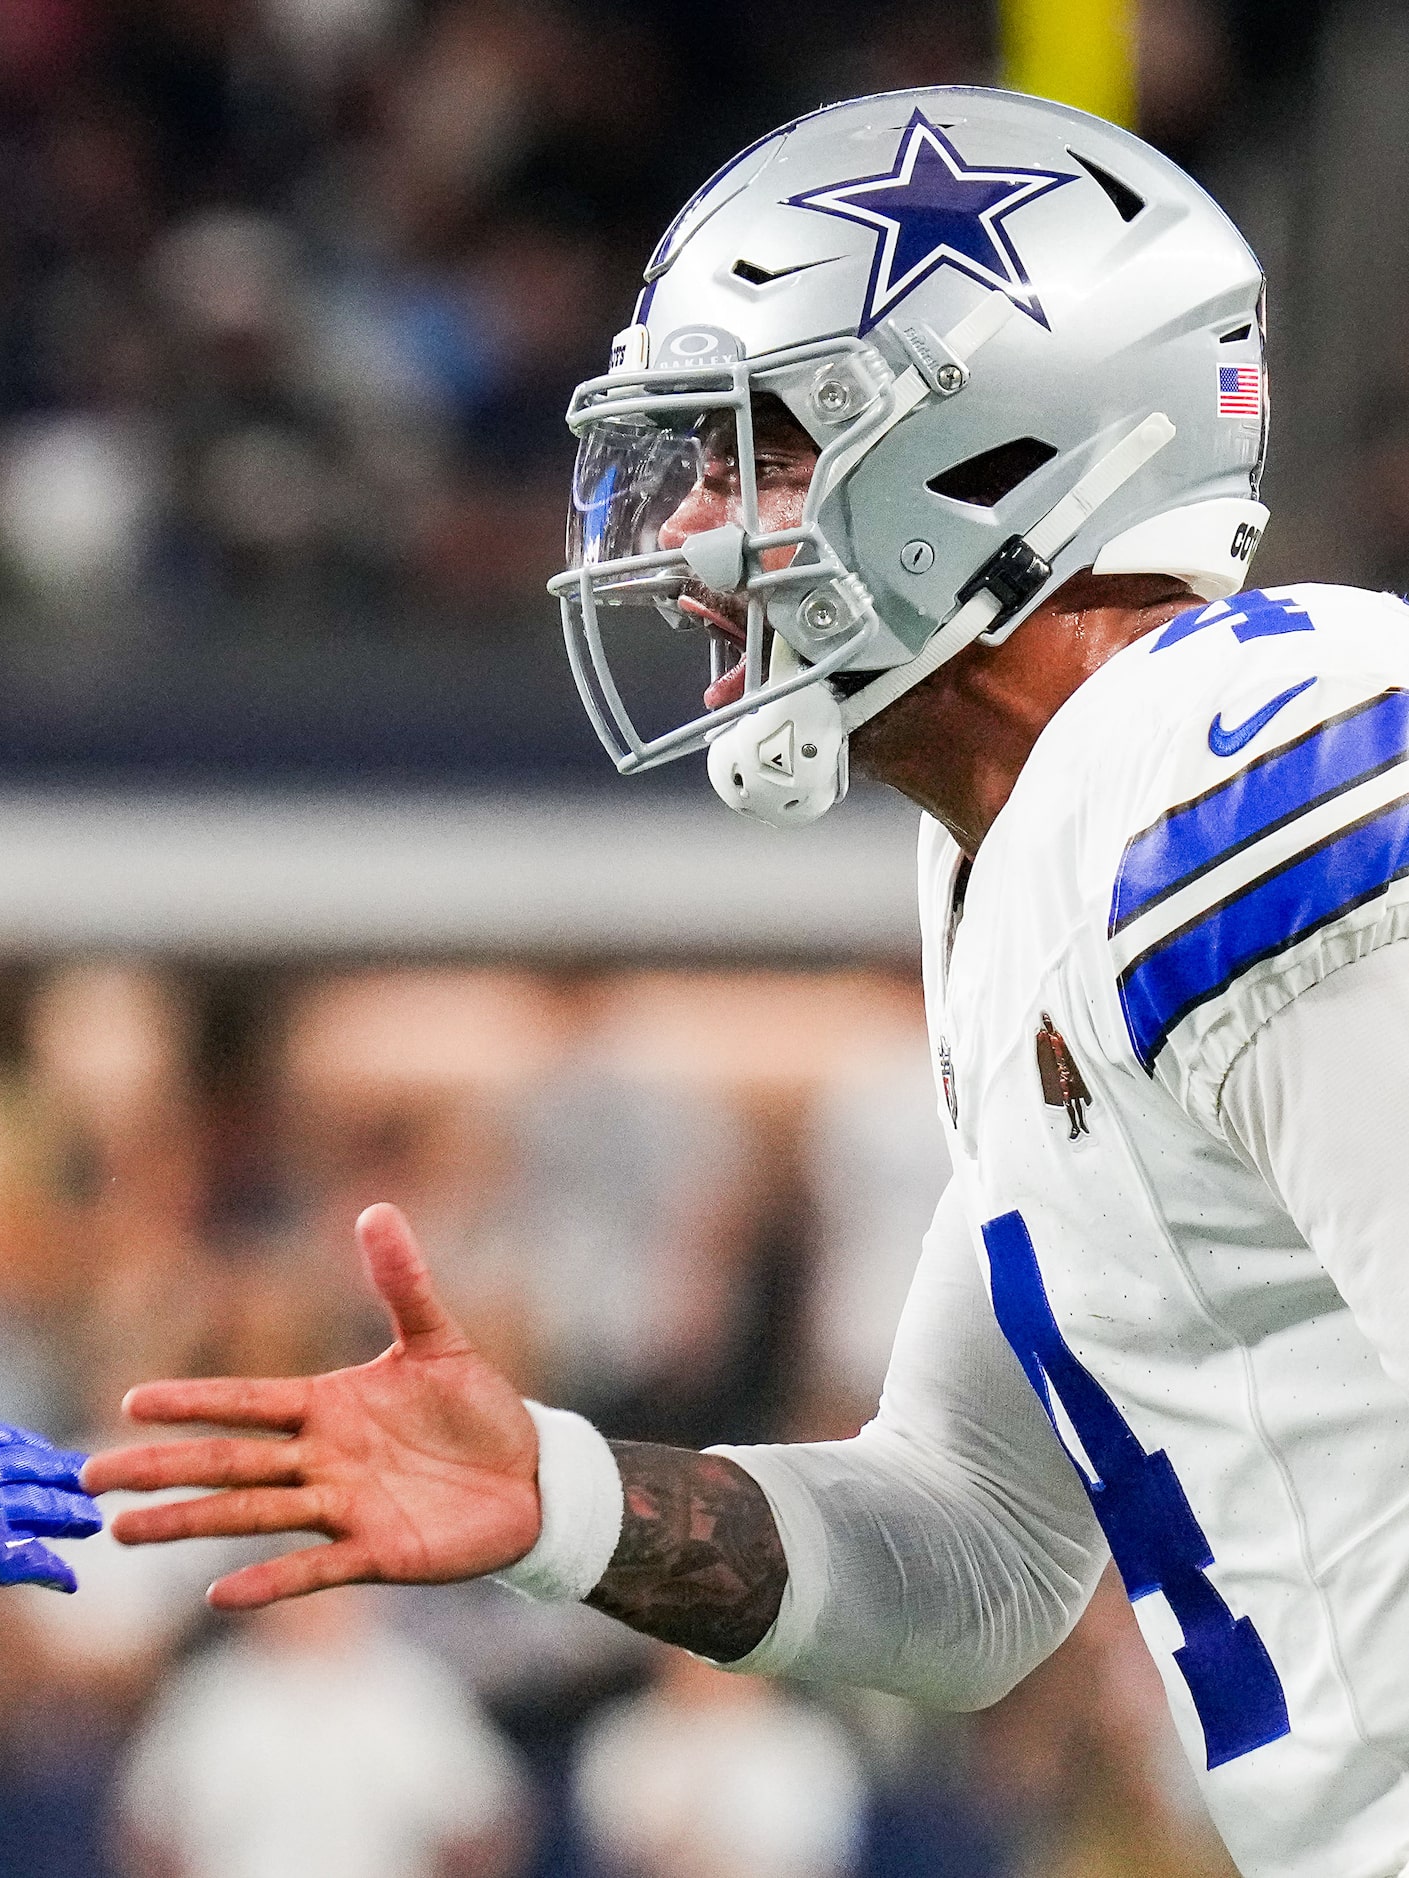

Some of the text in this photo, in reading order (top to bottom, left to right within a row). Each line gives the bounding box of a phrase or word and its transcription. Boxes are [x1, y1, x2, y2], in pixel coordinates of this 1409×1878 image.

[660, 354, 732, 369] OAKLEY
[1149, 588, 1315, 654] 4
[981, 1209, 1290, 1771] 4
